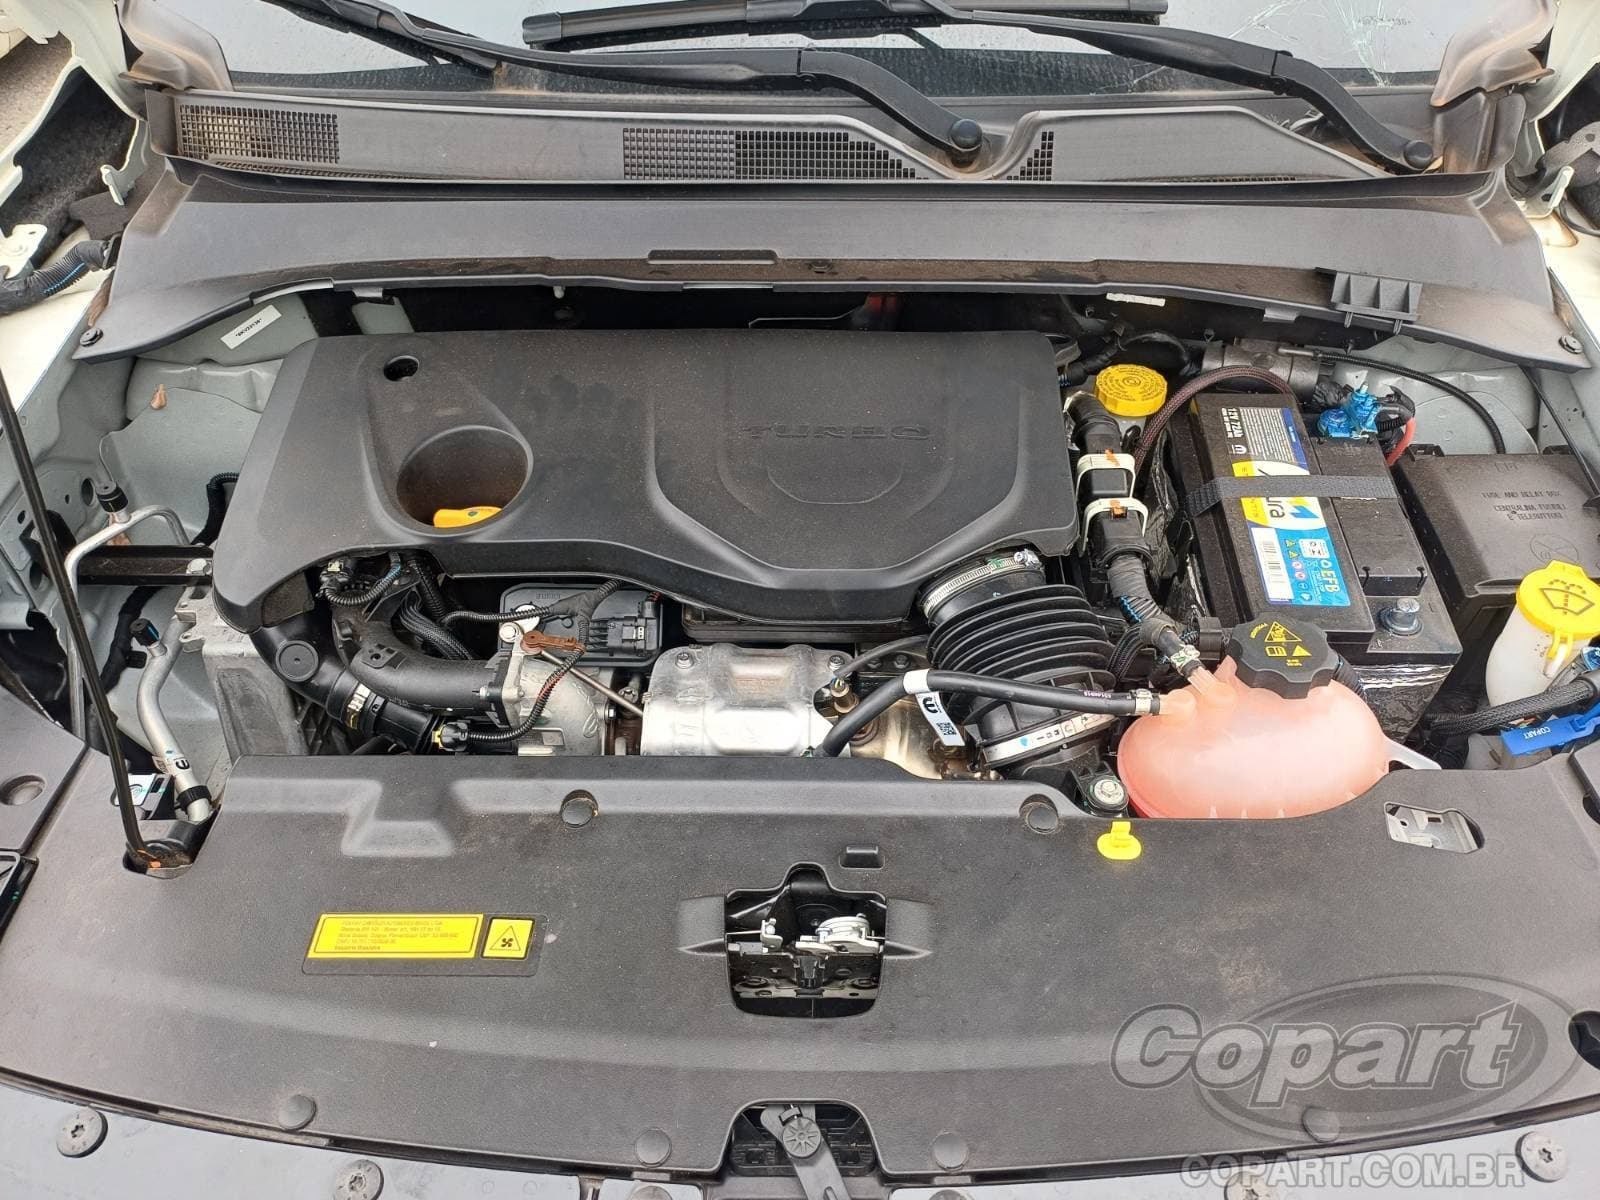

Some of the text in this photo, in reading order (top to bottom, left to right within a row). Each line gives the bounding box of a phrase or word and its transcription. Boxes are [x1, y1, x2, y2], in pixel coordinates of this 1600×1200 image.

[741, 424, 931, 440] TURBO
[1320, 569, 1340, 593] EFB
[1522, 726, 1551, 740] COPART
